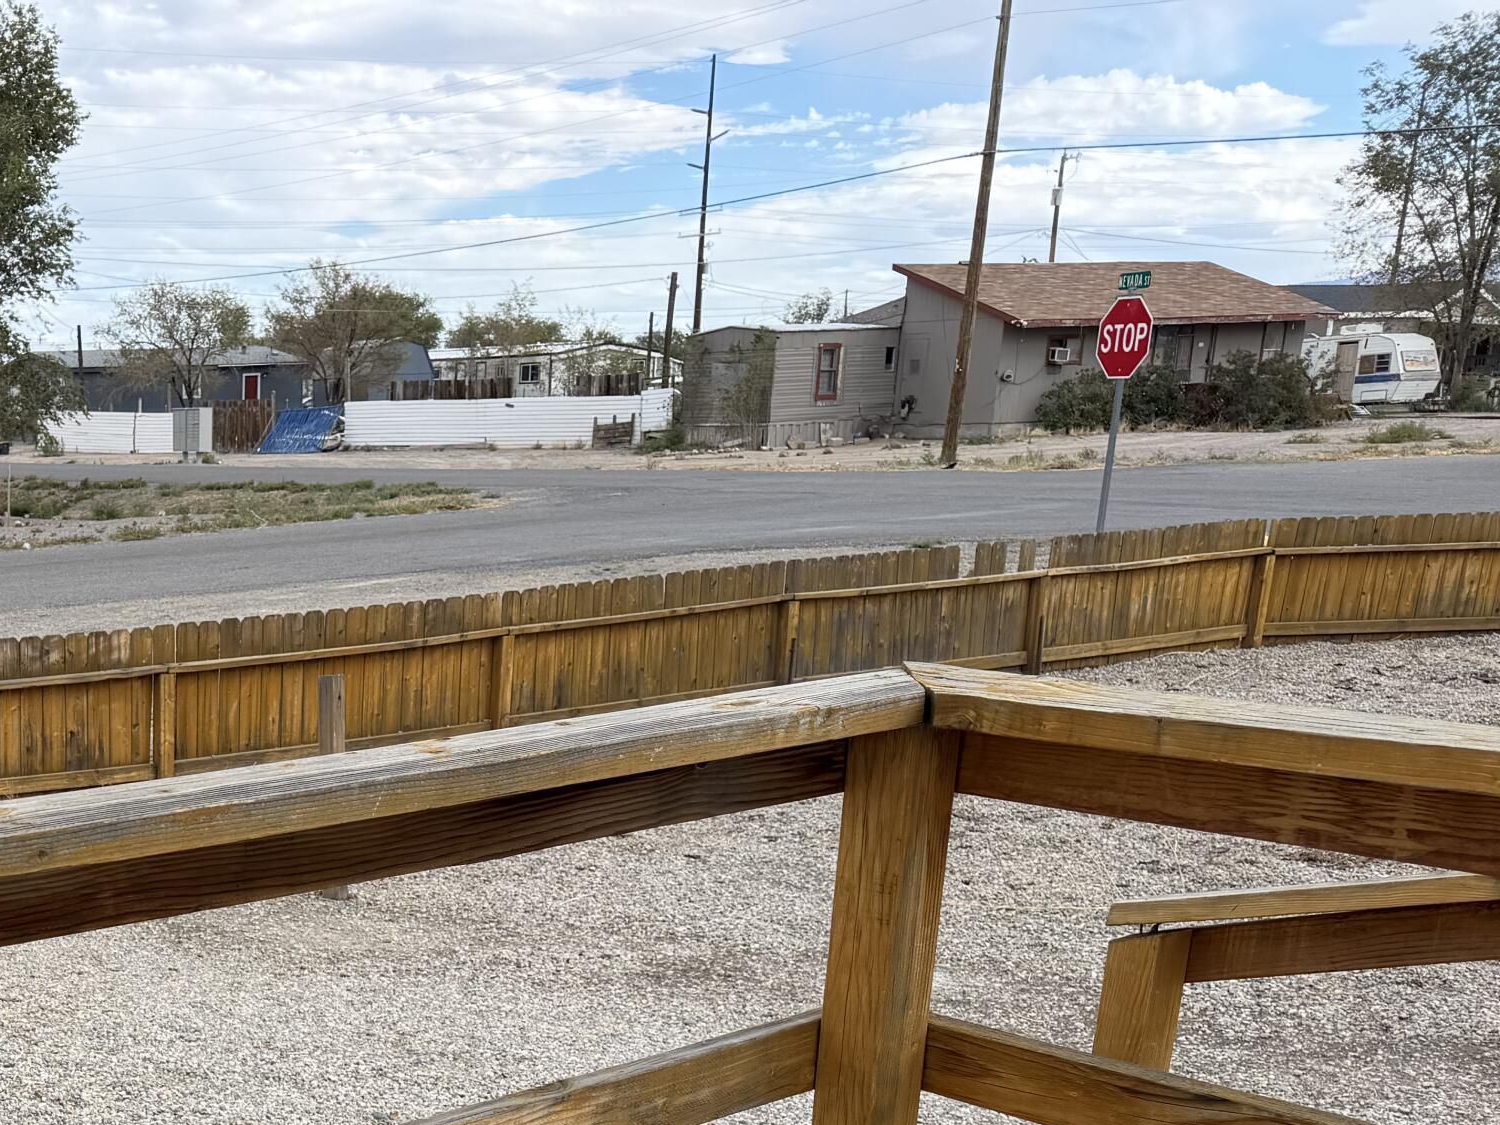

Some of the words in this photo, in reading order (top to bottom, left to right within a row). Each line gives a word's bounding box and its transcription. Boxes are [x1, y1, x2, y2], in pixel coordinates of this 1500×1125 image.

[1119, 273, 1143, 288] NEVADA
[1144, 276, 1151, 286] ST
[1101, 322, 1148, 353] STOP
